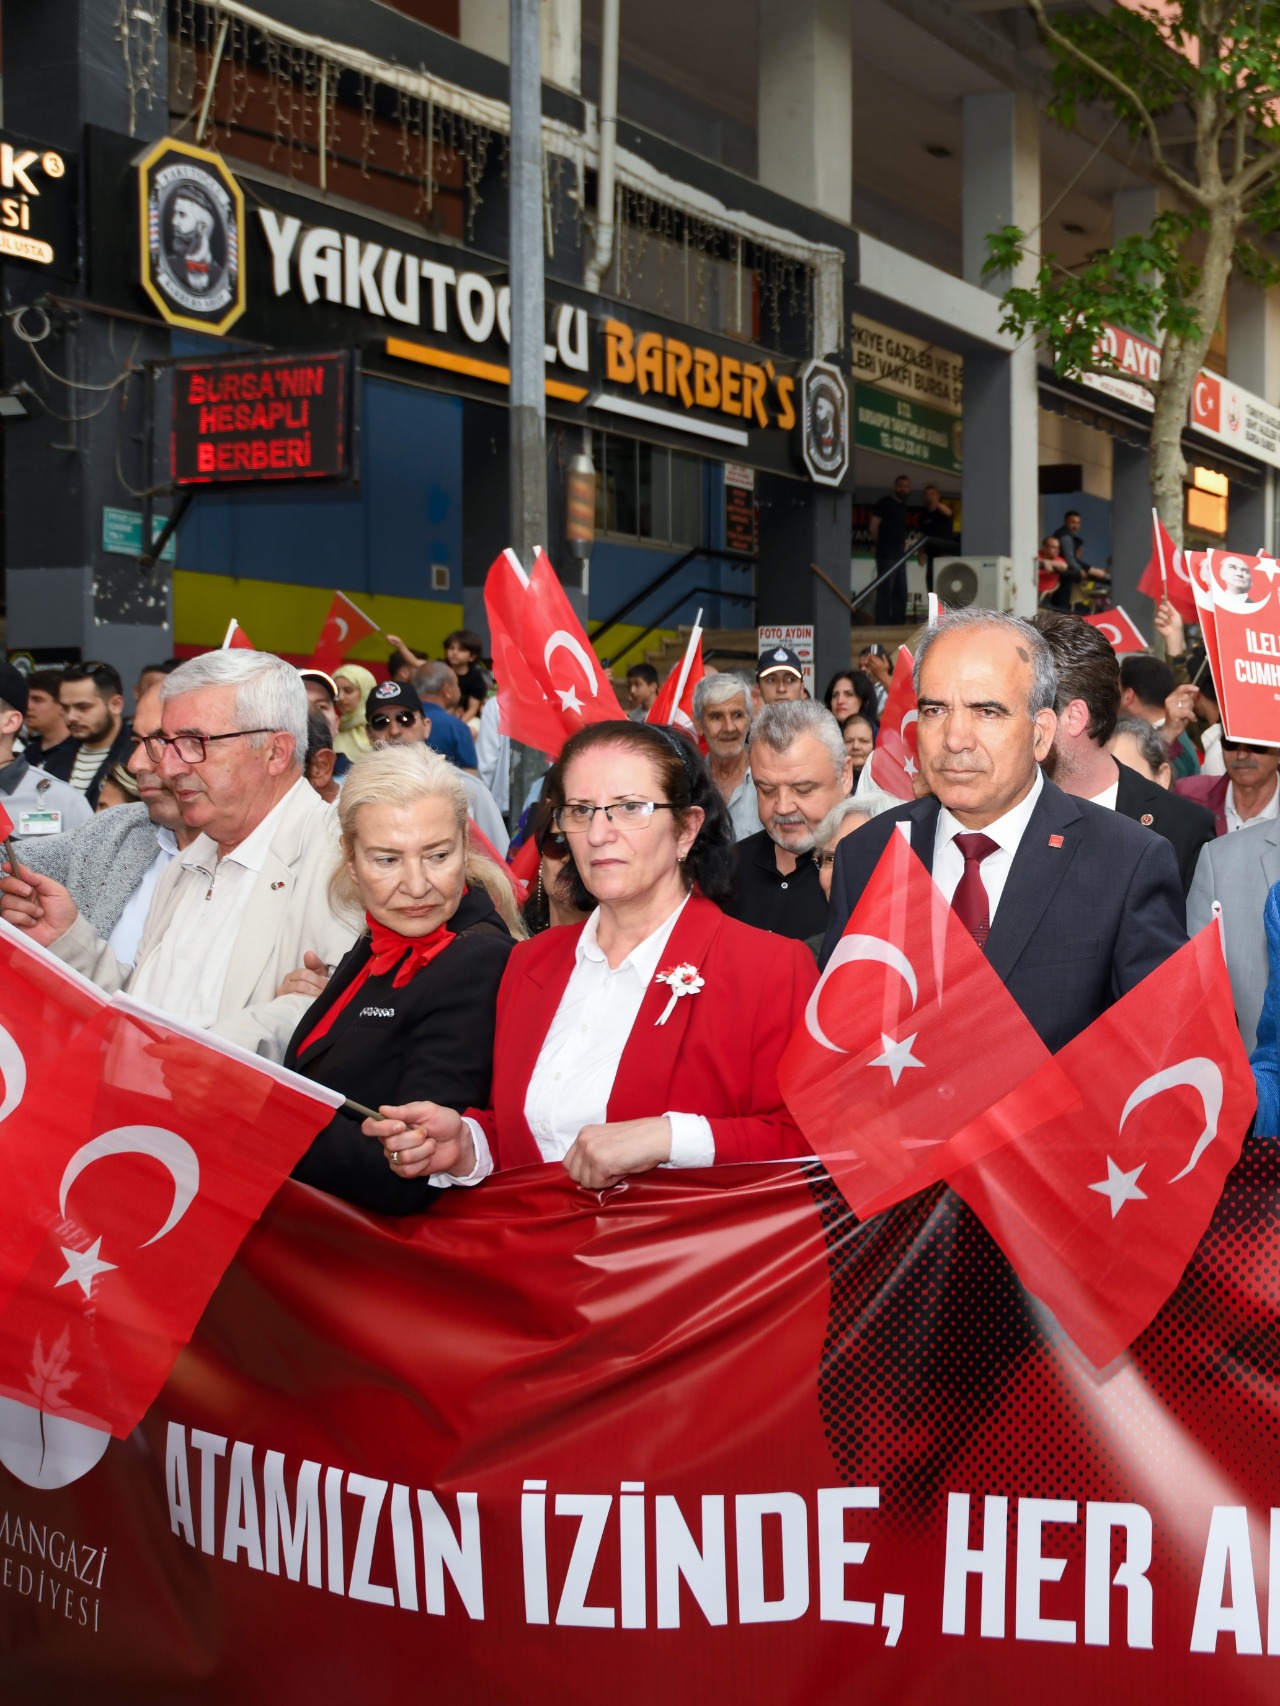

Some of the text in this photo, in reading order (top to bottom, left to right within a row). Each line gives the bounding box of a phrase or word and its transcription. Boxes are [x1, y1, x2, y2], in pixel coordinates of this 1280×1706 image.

[188, 365, 324, 405] BURSA'NIN
[605, 317, 796, 430] BARBER'S
[198, 398, 309, 435] HESAPLI
[197, 430, 312, 473] BERBERİ
[759, 627, 812, 639] FOTO AYDIN
[166, 1421, 485, 1620] ATAMIZIN
[520, 1479, 905, 1647] İZİNDE,
[942, 1491, 1154, 1649] HER
